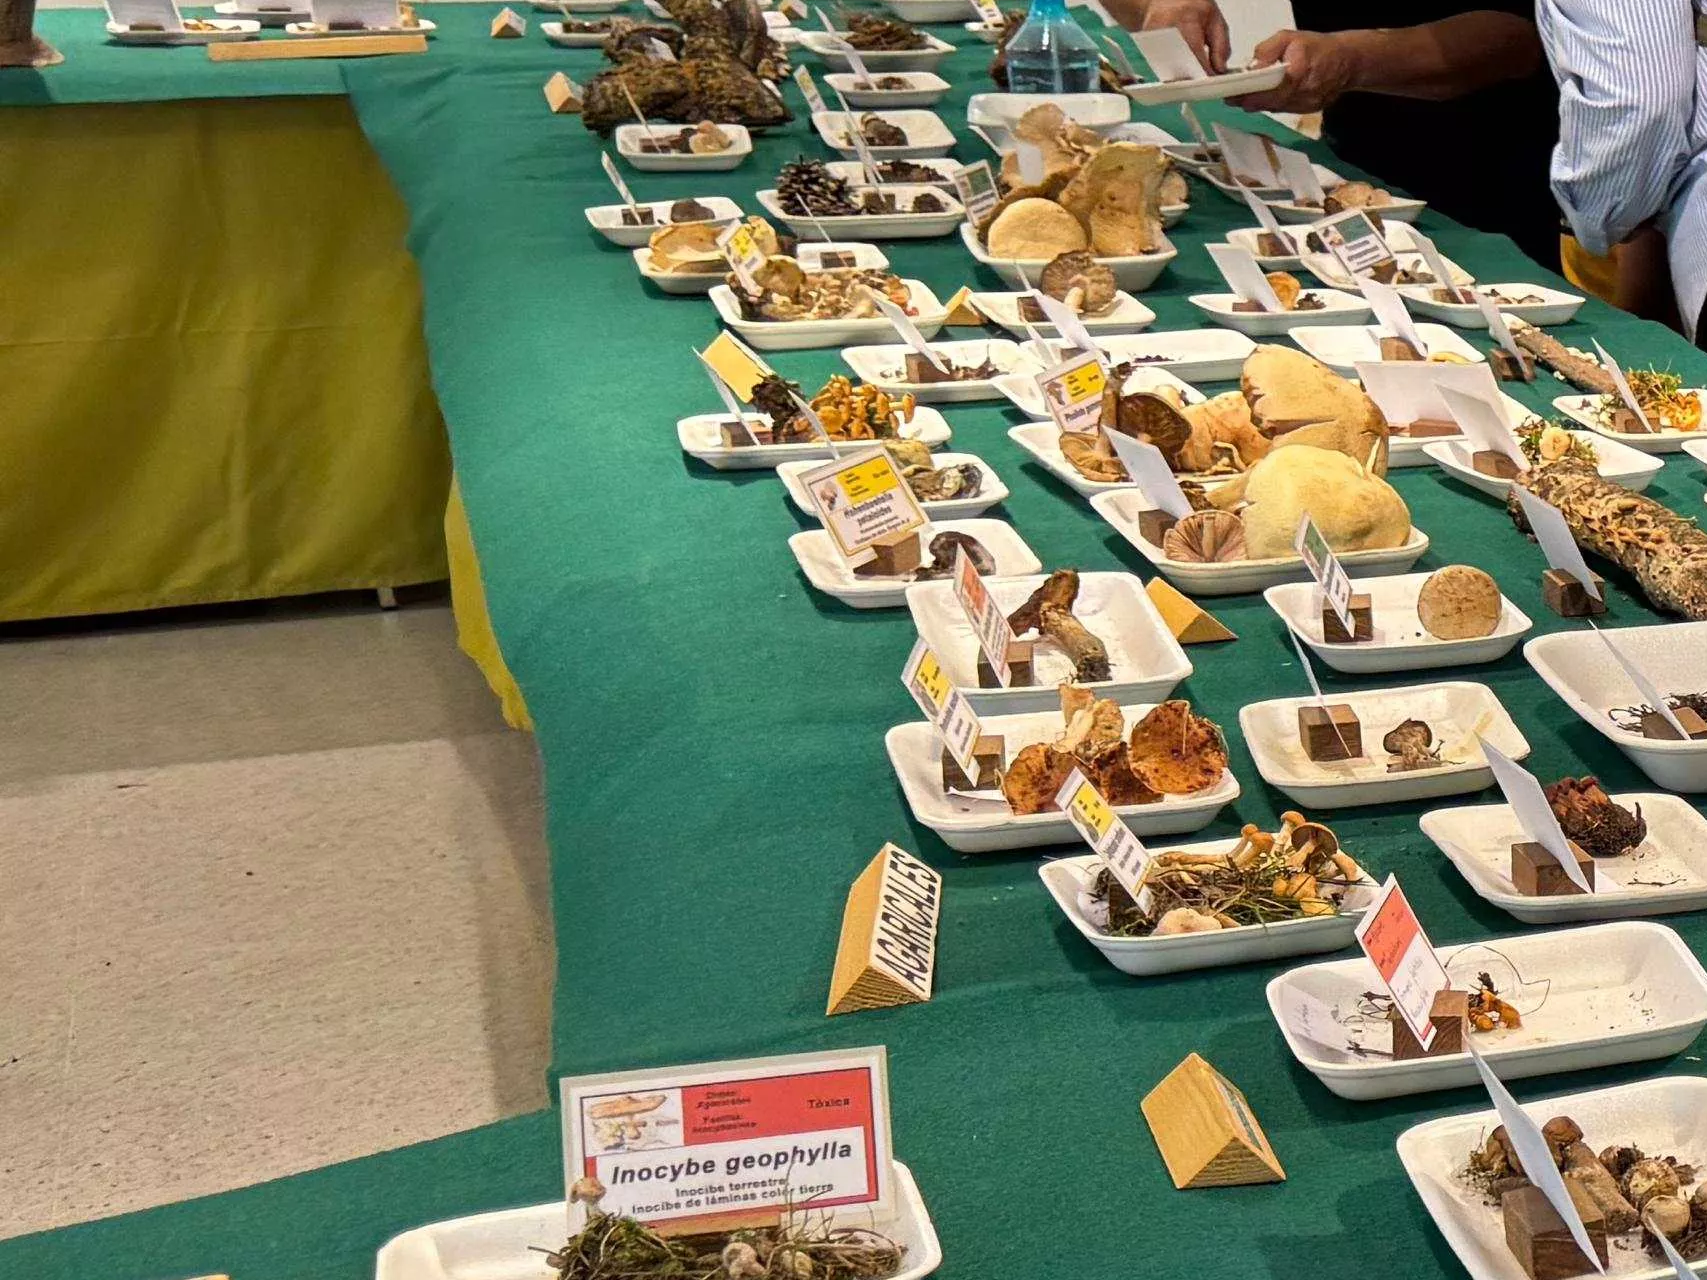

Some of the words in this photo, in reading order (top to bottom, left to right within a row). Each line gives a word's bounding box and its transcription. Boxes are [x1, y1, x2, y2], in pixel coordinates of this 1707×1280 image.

[876, 850, 939, 992] AGARICALES
[611, 1159, 716, 1185] Inocybe
[726, 1141, 852, 1176] geophylla
[632, 1200, 682, 1215] Inocibe
[685, 1197, 702, 1208] de
[705, 1191, 757, 1207] láminas
[675, 1182, 725, 1198] Inocibe
[729, 1178, 787, 1194] terrestre
